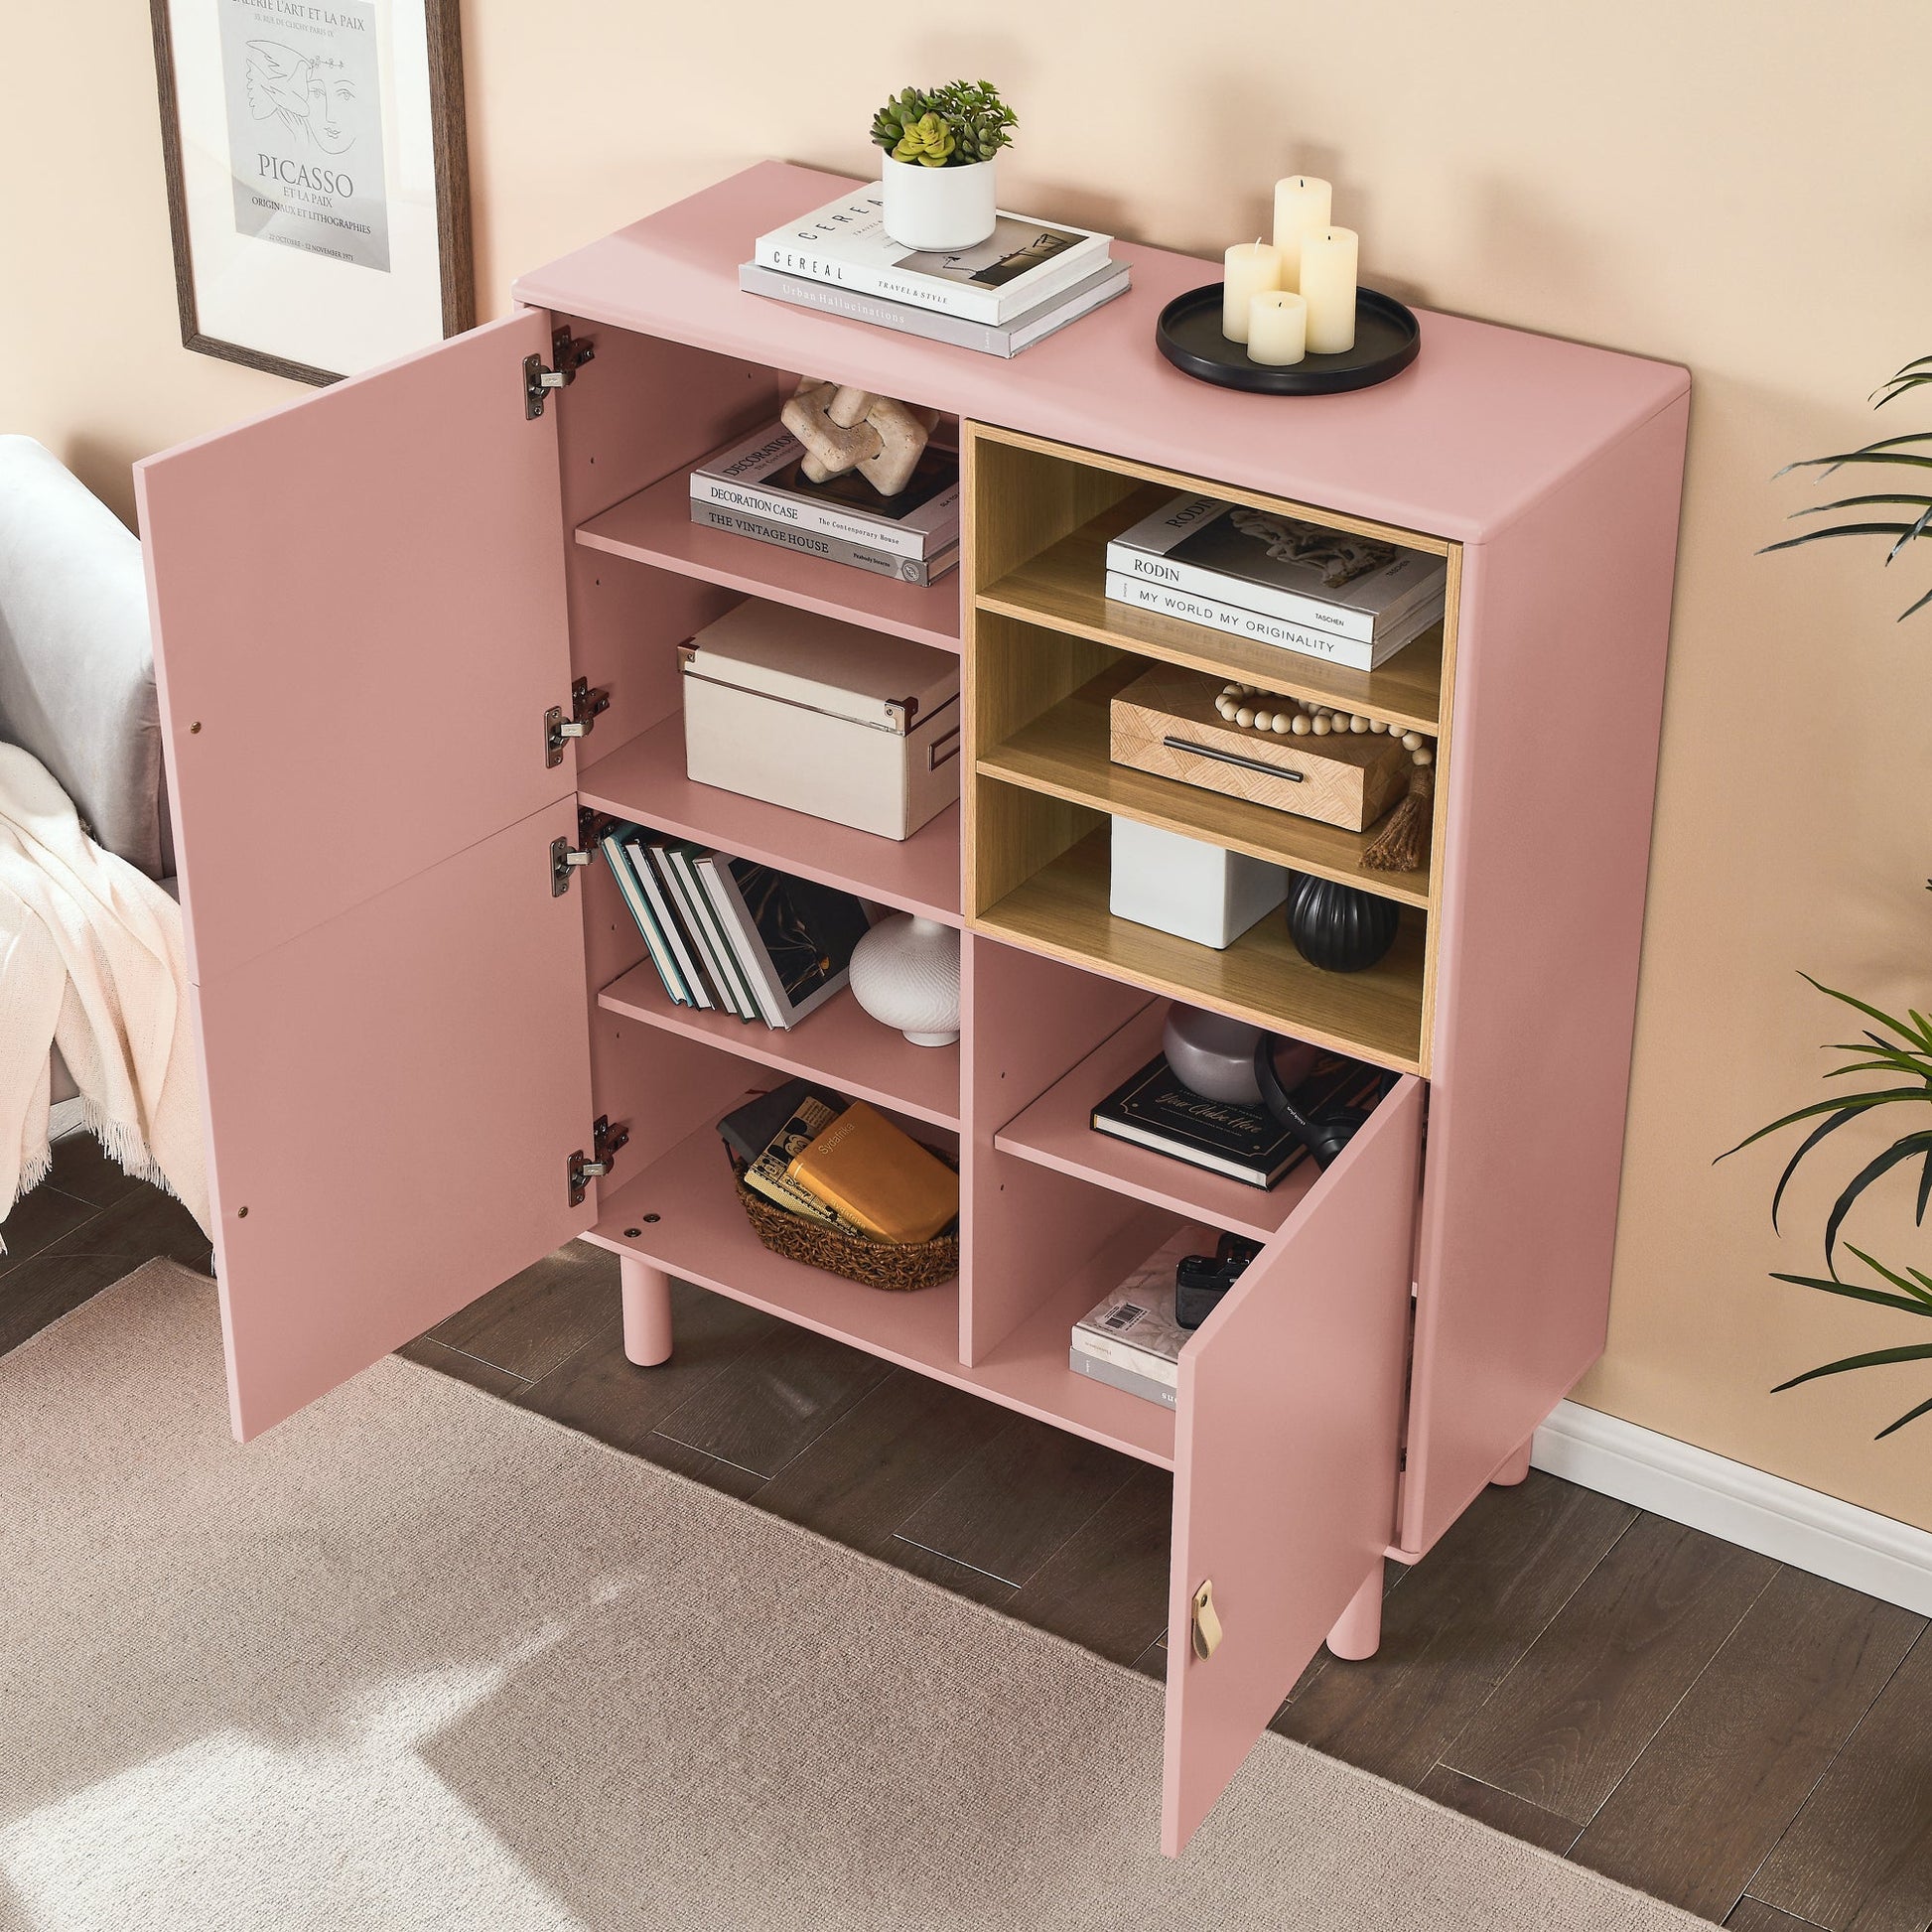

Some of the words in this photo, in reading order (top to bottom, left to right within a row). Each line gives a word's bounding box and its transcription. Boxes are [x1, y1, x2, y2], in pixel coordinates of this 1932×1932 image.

[277, 1, 305, 17] L'ART
[308, 8, 321, 21] ET
[324, 11, 338, 25] LA
[340, 15, 365, 31] PAIX
[258, 153, 353, 198] PICASSO
[283, 187, 296, 198] ET
[298, 191, 310, 202] LA
[311, 194, 334, 207] PAIX
[251, 197, 296, 215] ORIGINAUX
[297, 207, 308, 218] ET
[308, 211, 371, 234] LITHOGRAPHIES
[797, 199, 883, 240] CEREA
[773, 251, 843, 280] CEREAL
[782, 284, 817, 301] Urban
[819, 293, 905, 324] Hallucinations
[878, 280, 911, 296] TRAVEL
[920, 291, 947, 304] STYLE
[710, 486, 772, 513] DECORATION
[772, 502, 798, 520] CASE
[709, 511, 734, 527] THE
[735, 518, 787, 542] VINTAGE
[788, 534, 830, 554] HOUSE
[819, 517, 831, 526] The
[832, 521, 878, 539] Contemporary
[880, 533, 899, 545] House
[1134, 558, 1180, 583] RODIN
[1139, 590, 1159, 603] MY
[1164, 597, 1214, 620] WORLD
[1219, 613, 1240, 626] MY
[1245, 620, 1335, 653] ORIGINALITY
[1314, 613, 1345, 627] TASCHEN
[817, 1122, 856, 1156] Sydafrika
